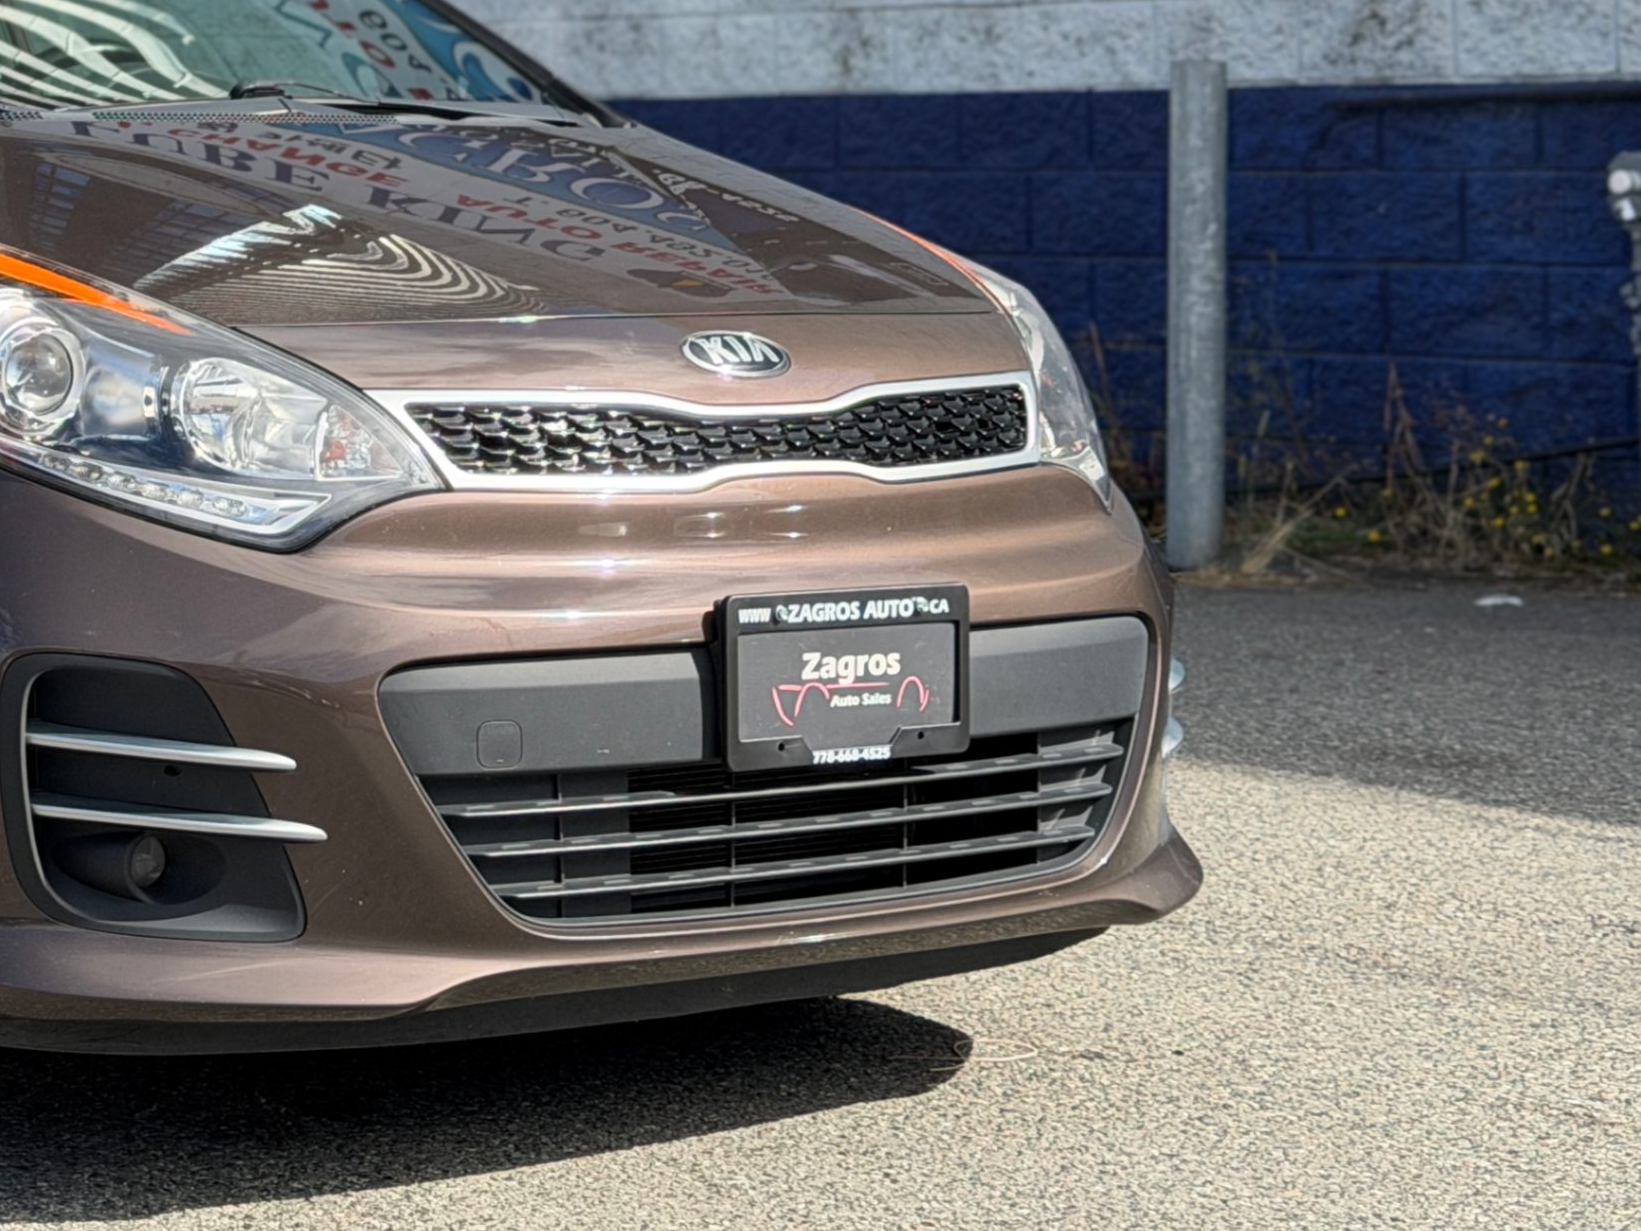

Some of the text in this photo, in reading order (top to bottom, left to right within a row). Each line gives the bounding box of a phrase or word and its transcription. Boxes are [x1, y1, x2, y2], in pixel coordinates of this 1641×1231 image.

[694, 334, 780, 365] KIA
[738, 598, 950, 624] WWW ZAGROS AUTO CA
[801, 652, 901, 684] Zagros
[830, 692, 892, 708] Auto Sales
